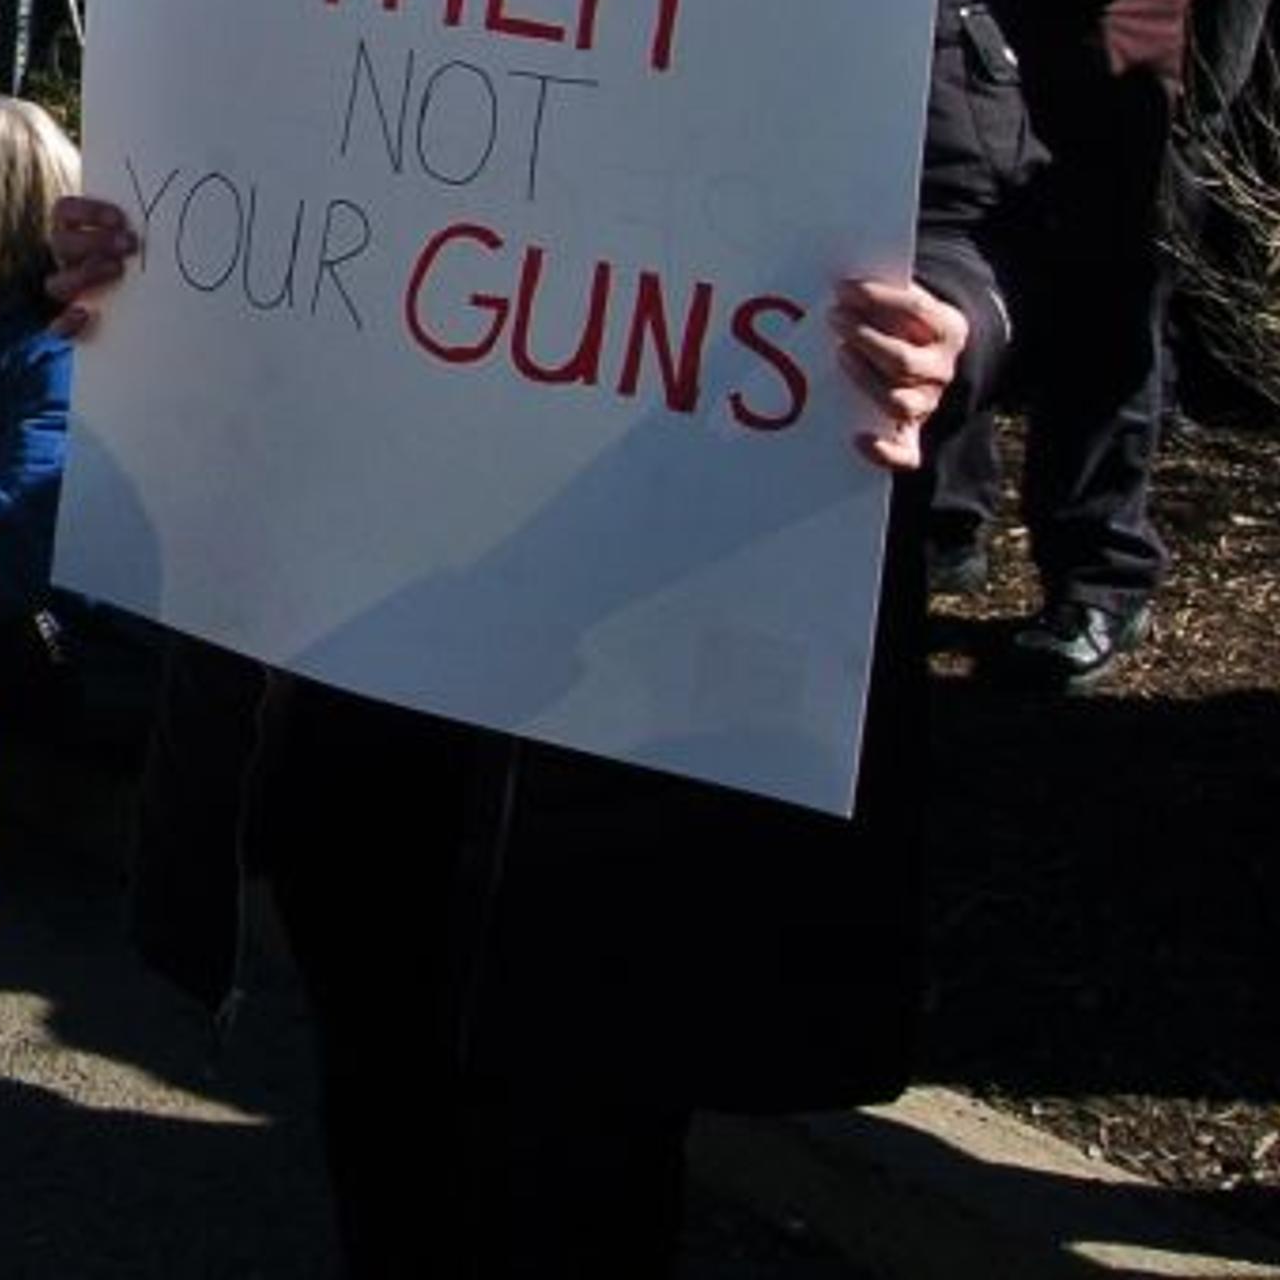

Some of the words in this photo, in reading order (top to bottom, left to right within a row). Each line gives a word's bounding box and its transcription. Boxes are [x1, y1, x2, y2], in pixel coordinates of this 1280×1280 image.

[340, 38, 600, 202] NOT
[123, 156, 373, 330] YOUR
[404, 223, 811, 431] GUNS
